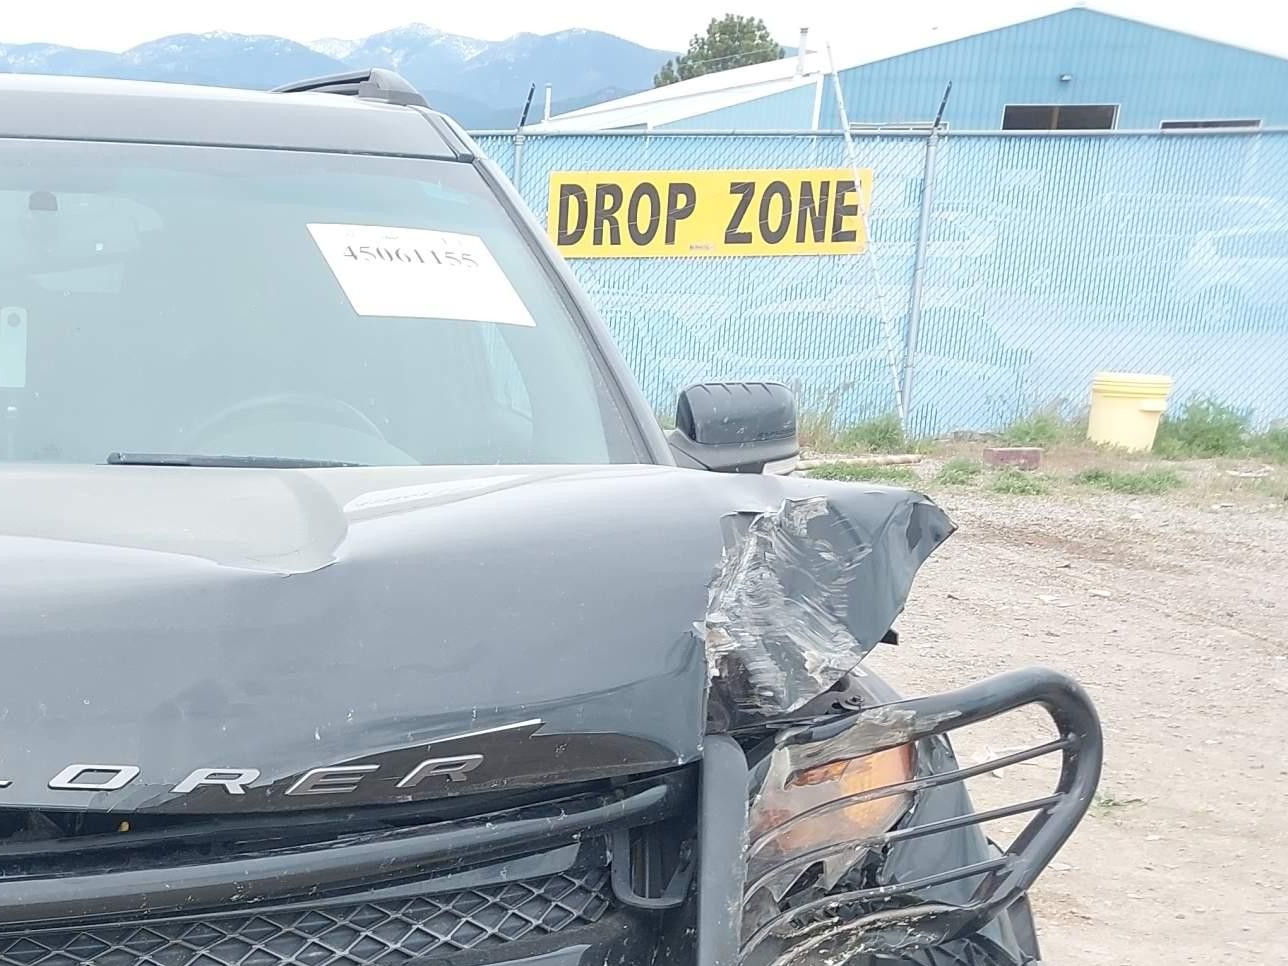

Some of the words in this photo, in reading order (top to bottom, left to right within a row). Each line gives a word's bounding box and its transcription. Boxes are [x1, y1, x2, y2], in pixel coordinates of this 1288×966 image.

[557, 182, 696, 247] DROP
[724, 179, 862, 246] ZONE
[343, 245, 479, 268] 45061155
